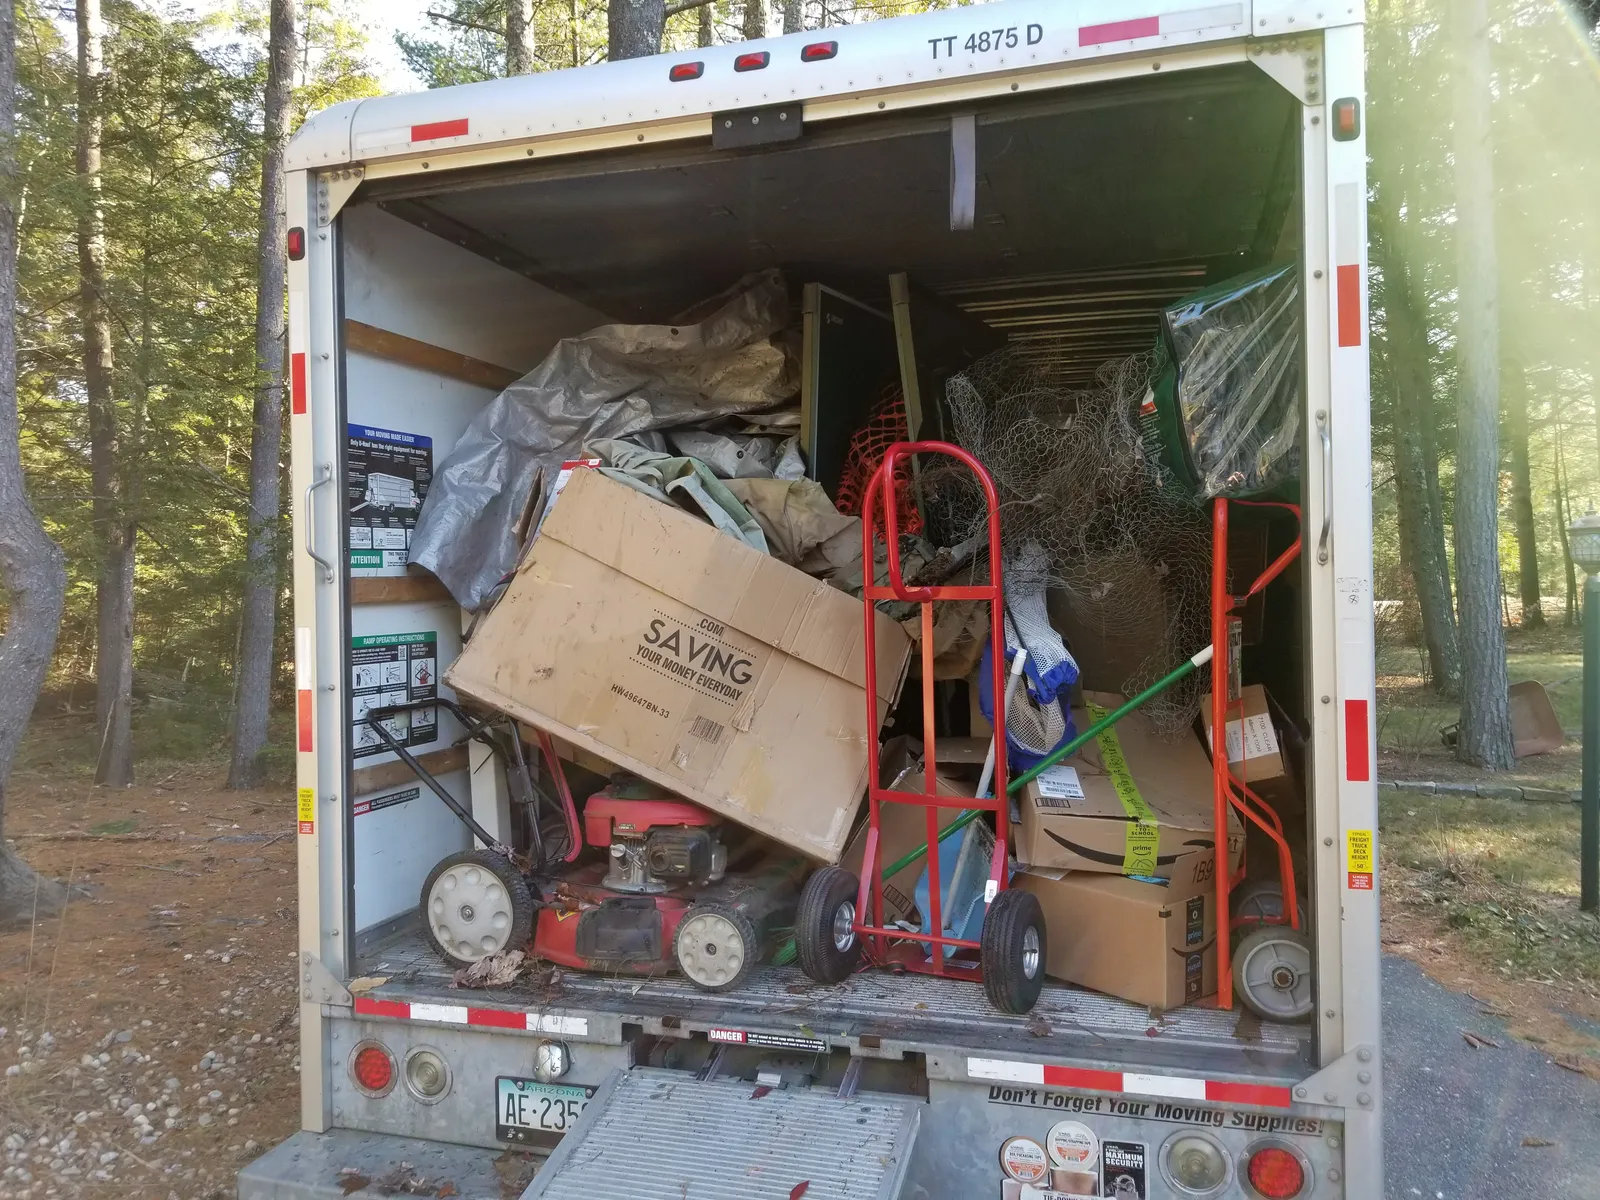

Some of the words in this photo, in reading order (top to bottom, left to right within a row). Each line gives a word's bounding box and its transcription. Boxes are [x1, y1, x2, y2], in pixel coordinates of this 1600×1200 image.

[928, 35, 957, 59] TT
[964, 27, 1018, 54] 4875
[1027, 23, 1043, 46] D
[350, 555, 380, 565] ATTENTION
[696, 618, 724, 636] .COM
[363, 637, 375, 645] RAMP
[376, 636, 398, 644] OPERATING
[398, 634, 425, 642] INSTRUCTIONS
[643, 618, 753, 685] SAVING
[636, 644, 662, 666] YOUR
[661, 657, 697, 682] MONEY
[696, 672, 743, 701] EVERYDAY
[611, 683, 670, 719] HW49647BN-33
[710, 1029, 743, 1042] DANGER
[525, 1085, 584, 1098] ARIZONA
[1043, 1091, 1103, 1113] Forget
[1109, 1098, 1150, 1117] Your
[1154, 1103, 1225, 1128] Moving
[1231, 1111, 1326, 1134] Supplies!
[1105, 1151, 1143, 1161] MAXIMUM
[1105, 1158, 1144, 1169] SECURITY
